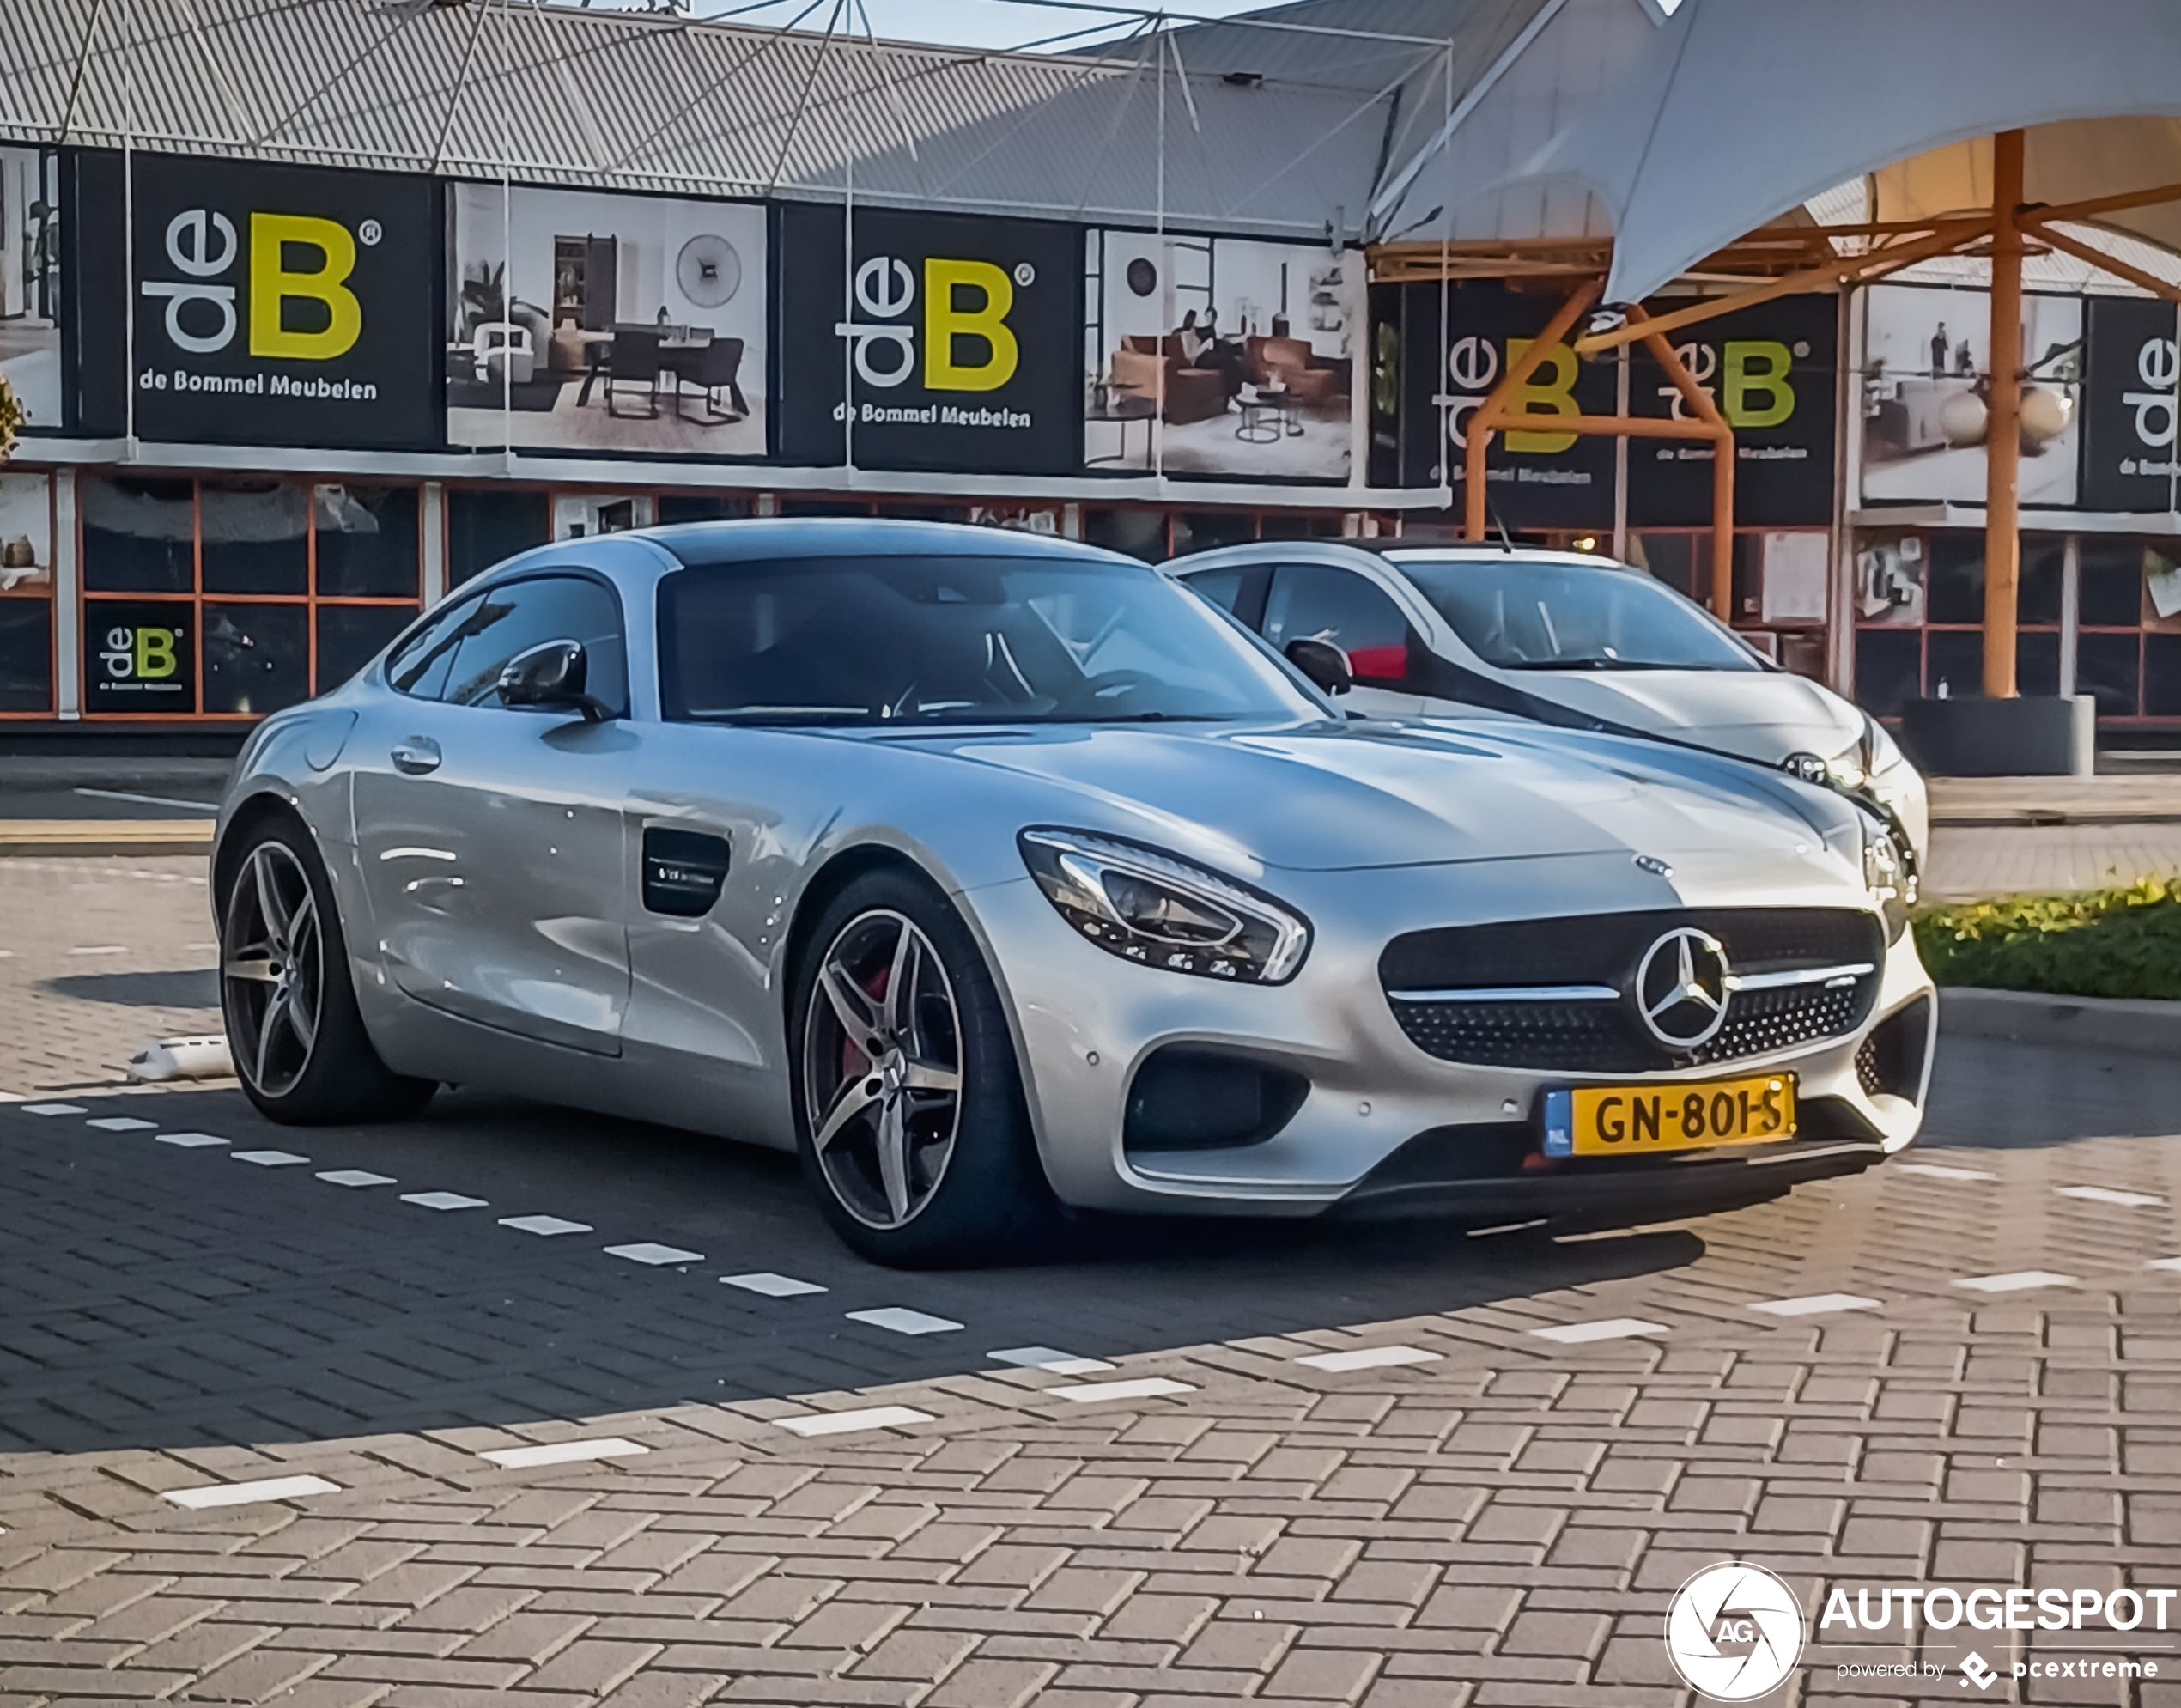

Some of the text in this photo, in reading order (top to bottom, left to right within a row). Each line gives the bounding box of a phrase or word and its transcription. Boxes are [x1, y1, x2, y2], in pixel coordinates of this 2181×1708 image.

[142, 209, 238, 353] de
[835, 256, 914, 387] de
[139, 368, 377, 400] de Bommel Meubelen
[861, 403, 937, 423] Bommel
[941, 405, 1030, 428] Meubelen
[100, 627, 133, 677] de
[1595, 1089, 1783, 1144] GN-801-S
